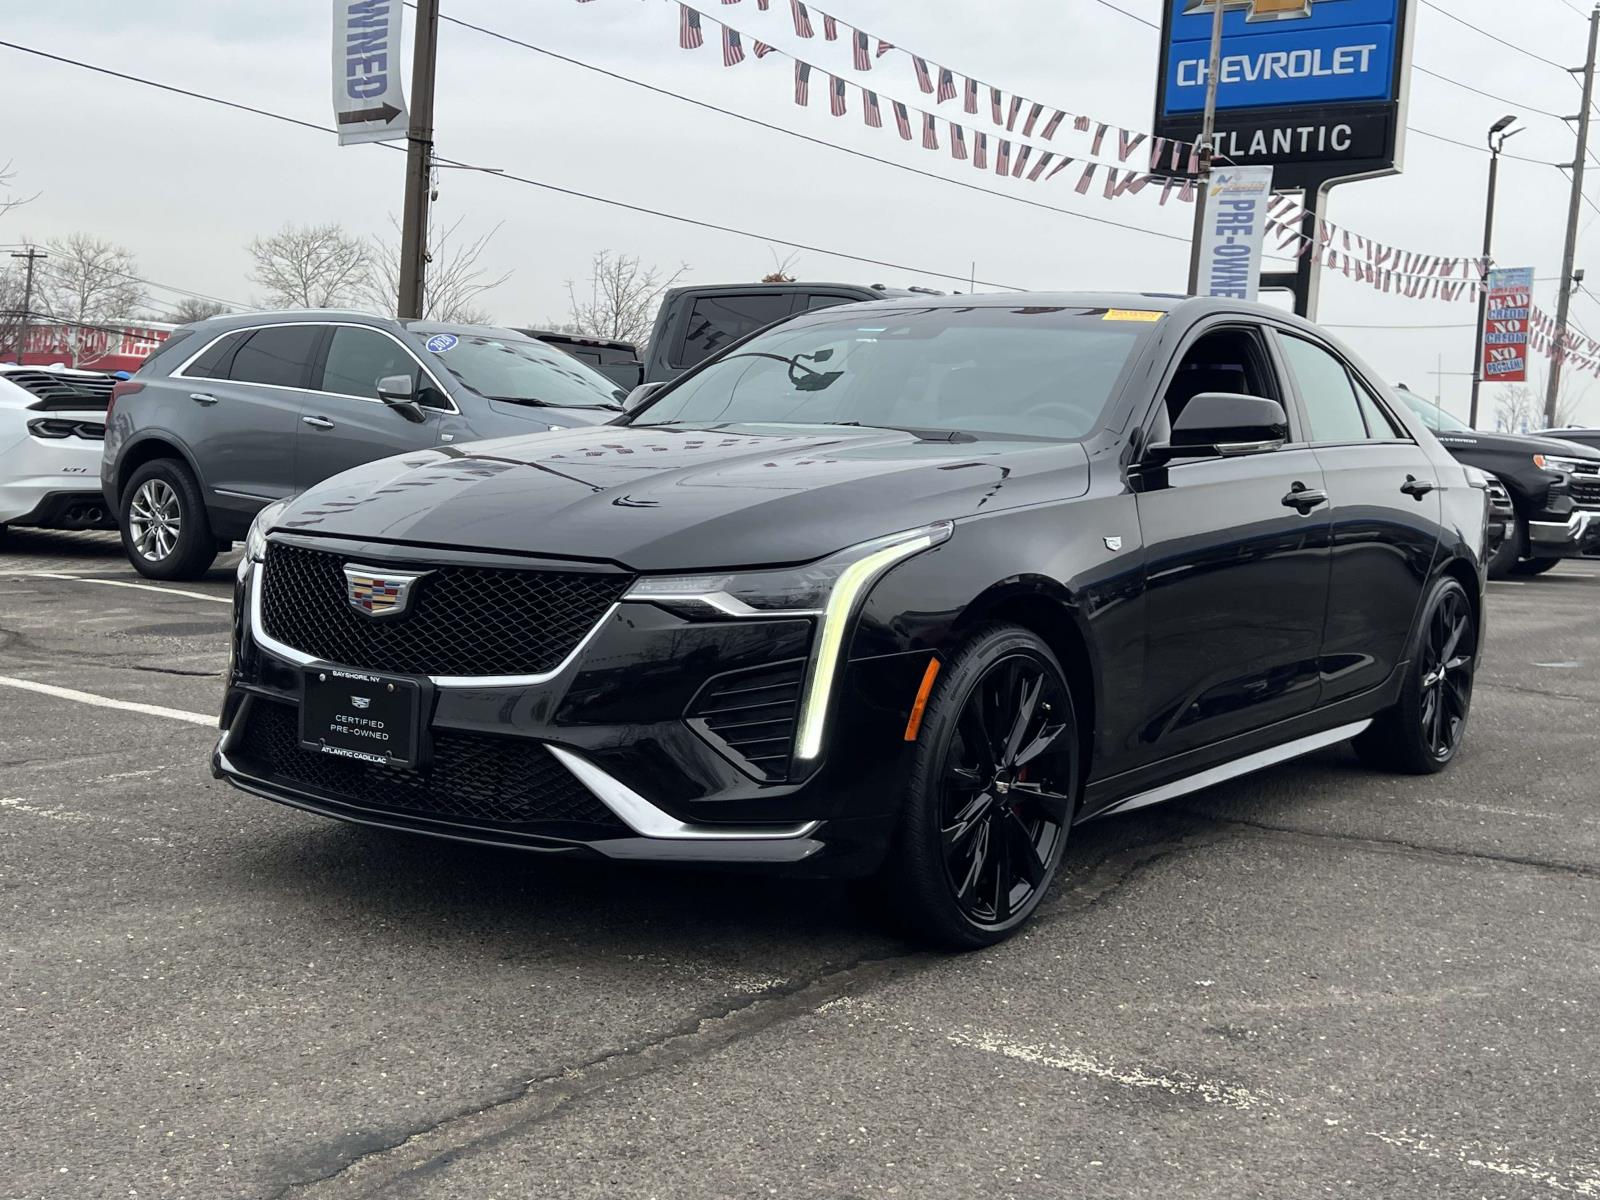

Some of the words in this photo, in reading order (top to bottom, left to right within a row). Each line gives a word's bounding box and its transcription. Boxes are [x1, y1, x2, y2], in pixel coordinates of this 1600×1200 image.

[1177, 44, 1376, 86] CHEVROLET
[1489, 294, 1529, 310] BAD
[1488, 308, 1528, 320] CREDIT
[1494, 320, 1520, 333] NO
[1486, 332, 1526, 344] CREDIT
[1490, 347, 1517, 361] NO
[335, 714, 385, 729] CERTIFIED
[330, 724, 389, 741] PRE-OWNED
[321, 746, 353, 758] ATLANTIC
[353, 753, 387, 764] CADILLAC
